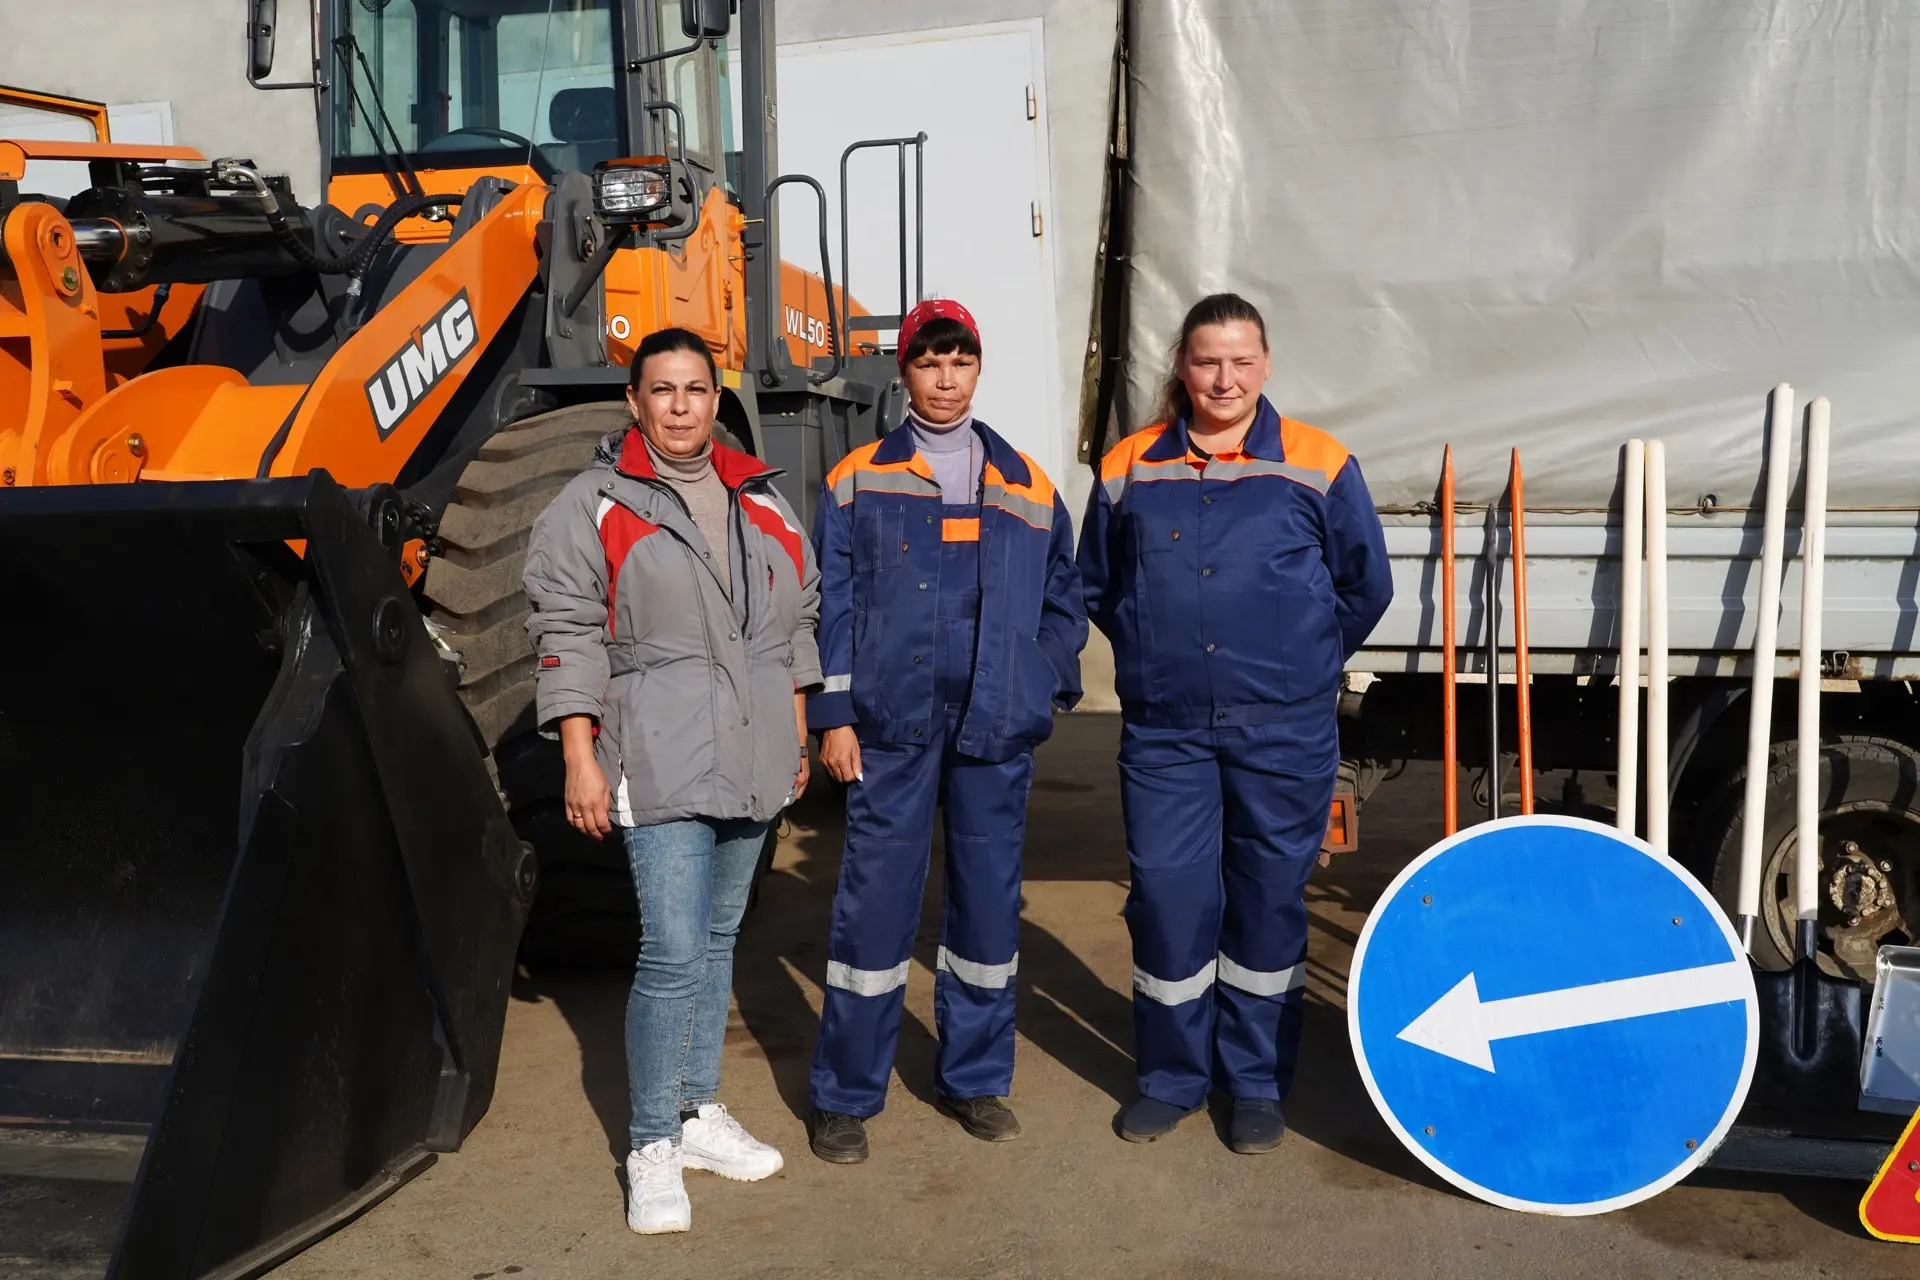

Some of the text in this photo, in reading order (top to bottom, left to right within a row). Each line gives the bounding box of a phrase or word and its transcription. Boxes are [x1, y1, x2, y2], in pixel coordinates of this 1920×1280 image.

[606, 314, 631, 340] 0
[784, 304, 825, 348] WL50
[368, 298, 474, 430] UMG
